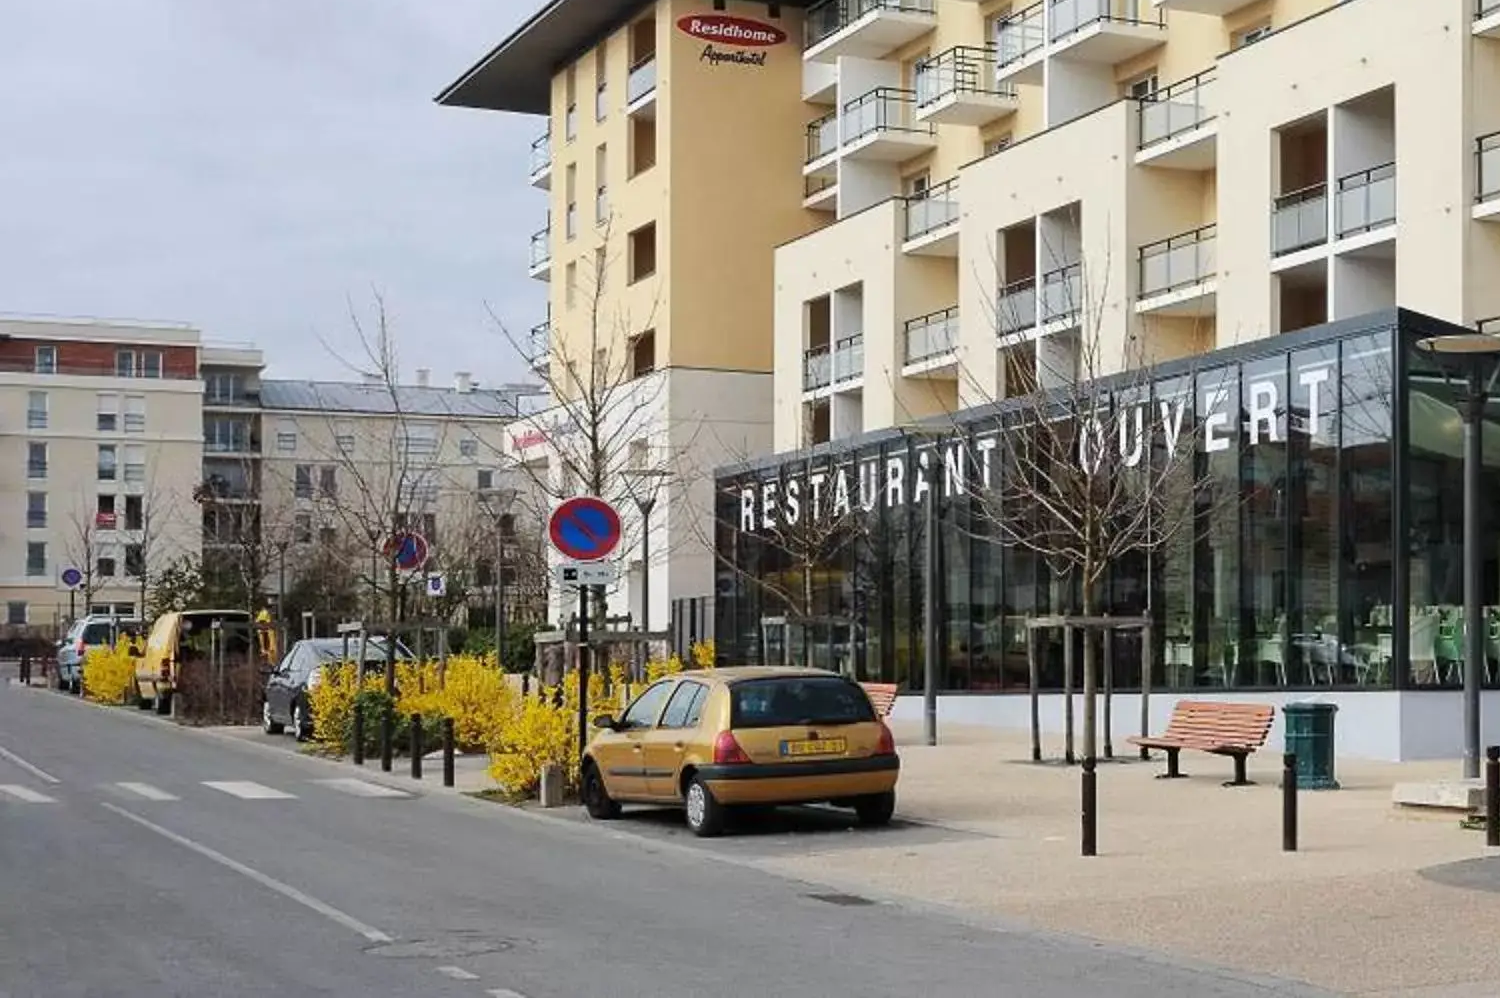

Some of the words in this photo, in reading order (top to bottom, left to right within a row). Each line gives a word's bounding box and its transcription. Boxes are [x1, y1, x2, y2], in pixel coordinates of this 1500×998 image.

[690, 19, 777, 42] Residhome
[699, 44, 767, 66] Apparthotel
[740, 438, 999, 532] RESTAURANT
[1078, 368, 1330, 474] OUVERT
